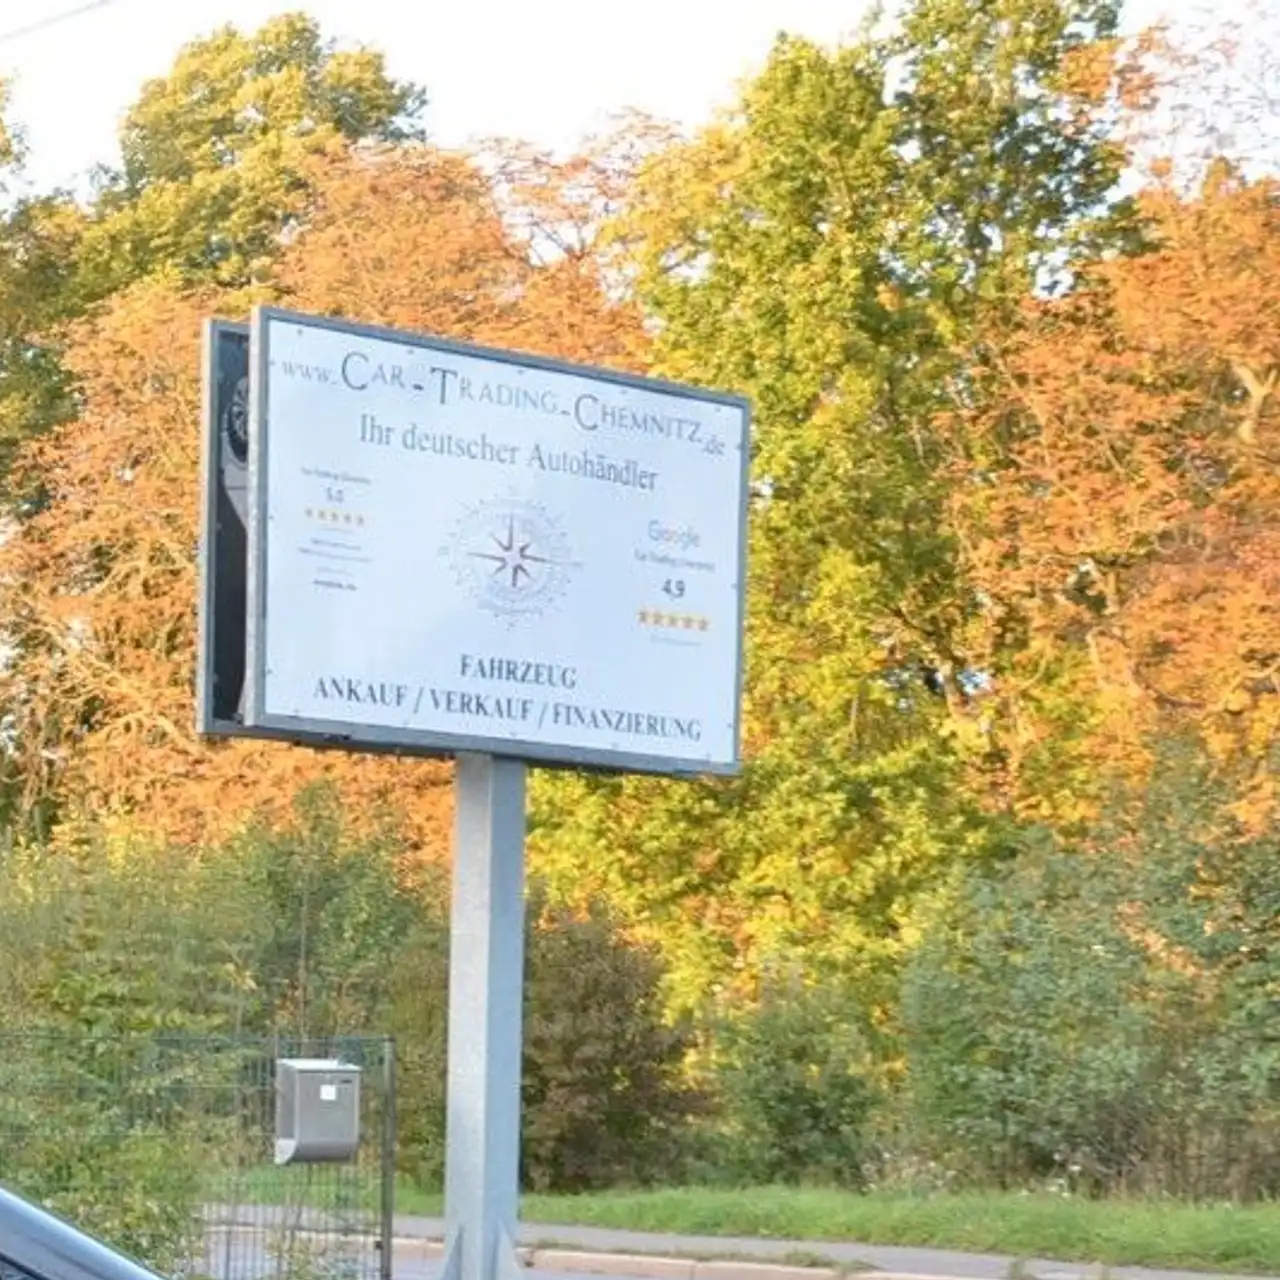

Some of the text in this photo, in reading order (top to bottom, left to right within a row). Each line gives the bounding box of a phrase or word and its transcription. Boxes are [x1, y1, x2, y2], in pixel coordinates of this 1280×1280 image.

[360, 413, 660, 491] Ihr deutscher Autohändler
[460, 653, 577, 690] FAHRZEUG
[313, 675, 408, 708] ANKAUF
[429, 687, 533, 722] VERKAUF
[552, 701, 702, 743] FINANZIERUNG
